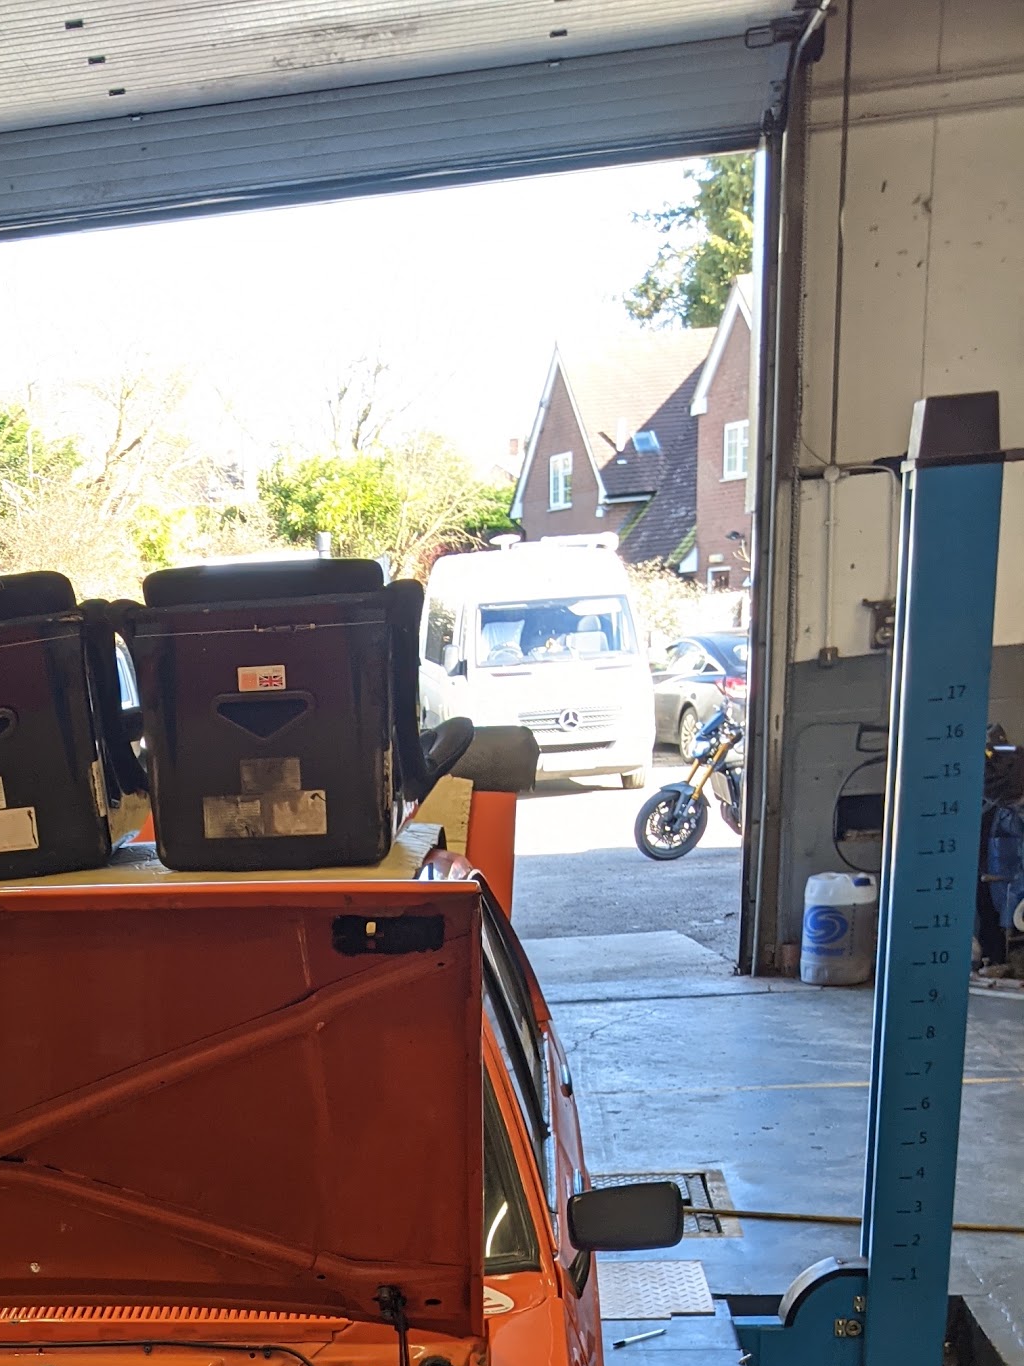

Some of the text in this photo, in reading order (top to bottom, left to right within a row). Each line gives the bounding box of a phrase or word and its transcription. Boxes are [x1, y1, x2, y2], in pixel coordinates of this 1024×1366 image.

[947, 684, 966, 700] 17
[946, 723, 964, 739] 16
[943, 762, 961, 777] 15
[940, 801, 958, 815] 14
[938, 839, 956, 853] 13
[935, 876, 954, 891] 12
[933, 914, 950, 928] 11
[931, 951, 949, 964] 10
[928, 988, 938, 1001] 9
[926, 1025, 935, 1039] 8
[924, 1061, 933, 1074] 7
[921, 1097, 930, 1110] 6
[919, 1131, 927, 1144] 5
[916, 1166, 924, 1178] 4
[914, 1200, 922, 1213] 3
[911, 1234, 920, 1246] 2
[910, 1267, 917, 1280] 1
